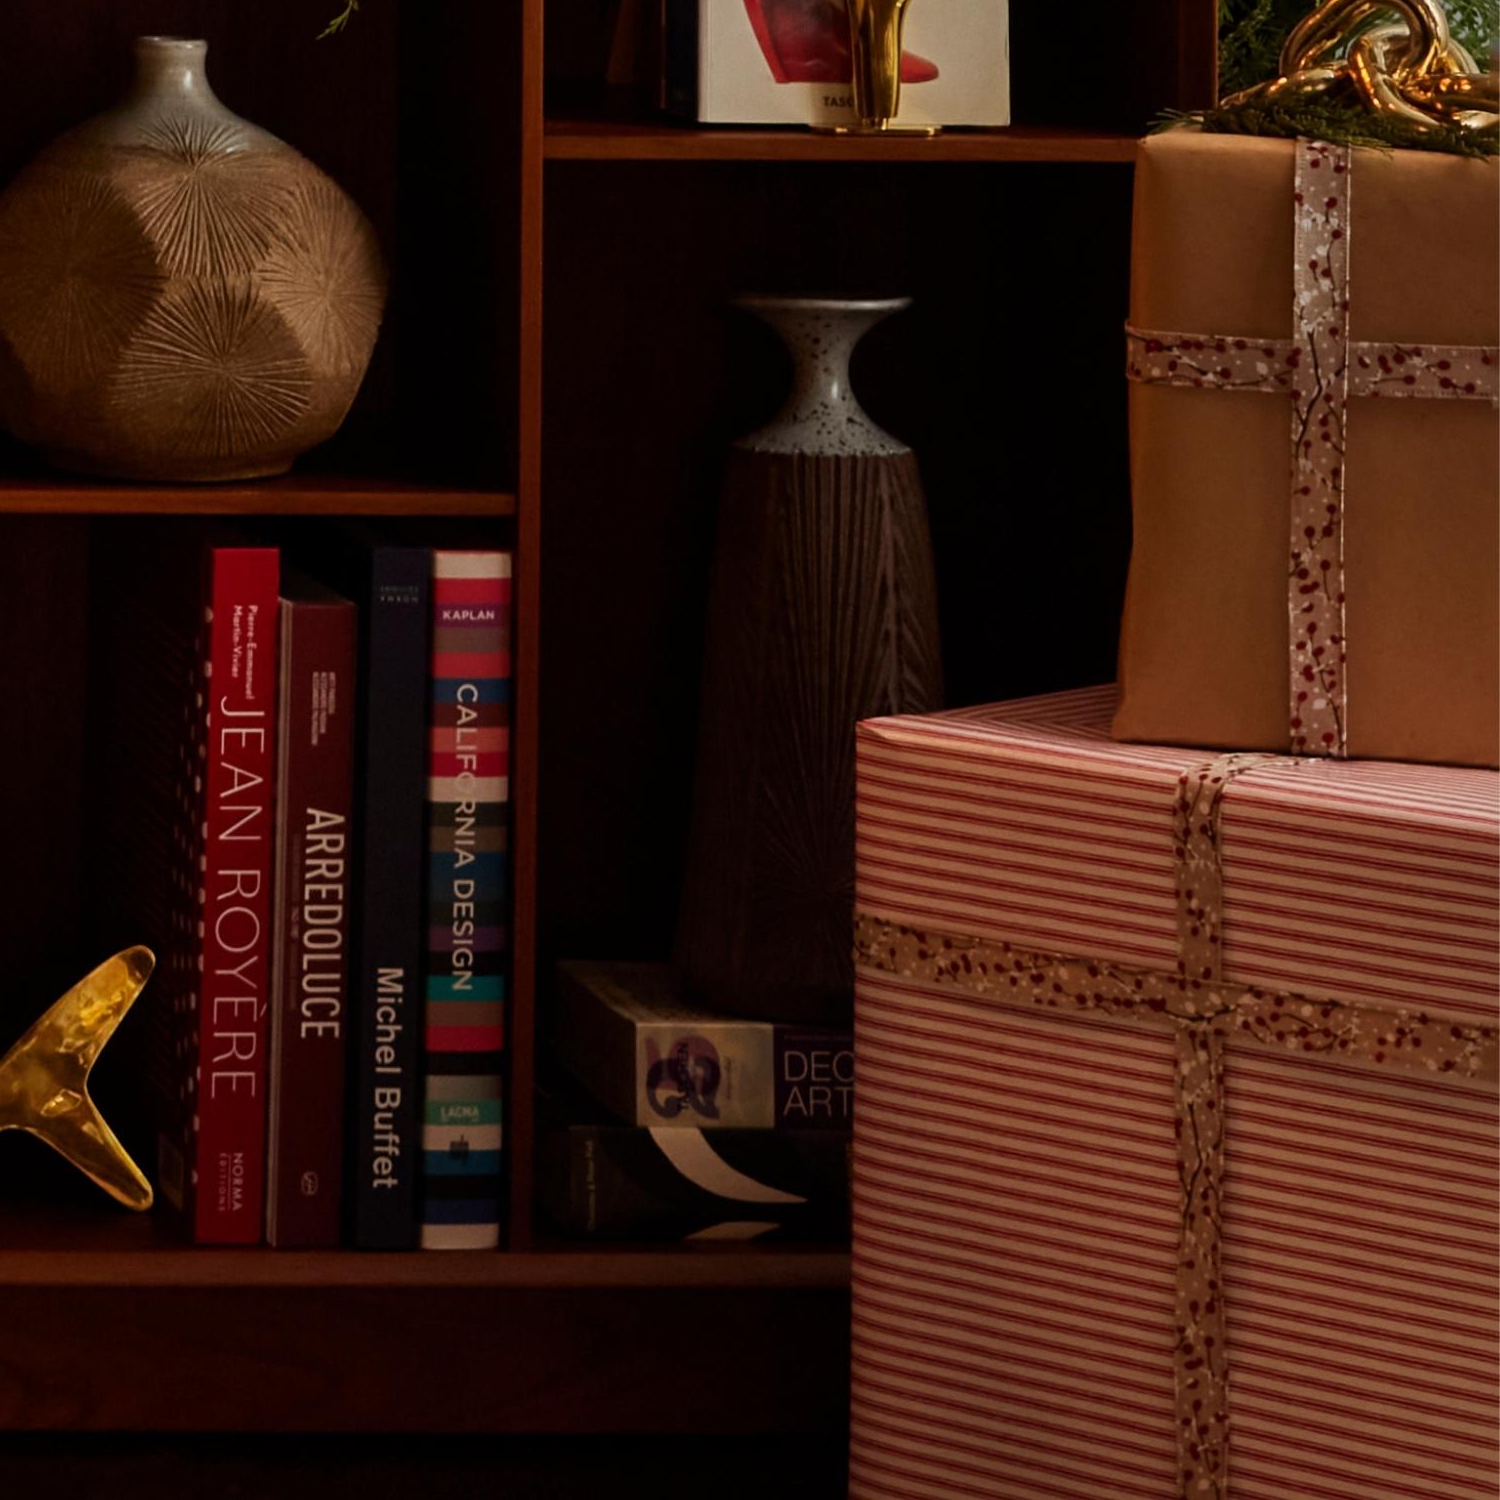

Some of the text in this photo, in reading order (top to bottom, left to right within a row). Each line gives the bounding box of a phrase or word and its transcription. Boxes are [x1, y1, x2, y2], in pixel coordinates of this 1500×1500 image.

[822, 95, 853, 107] TASC
[231, 604, 244, 679] Martin-Vivier
[245, 604, 259, 700] Pierre-Emmanuel
[441, 609, 496, 621] KAPLAN
[451, 682, 478, 993] CALIFORNIA DESIGN
[211, 695, 268, 1099] JEAN ROYÈRE
[300, 807, 345, 1039] ARREDOLUCE
[371, 967, 405, 1191] Michel Buffet
[231, 1152, 244, 1212] NORMA
